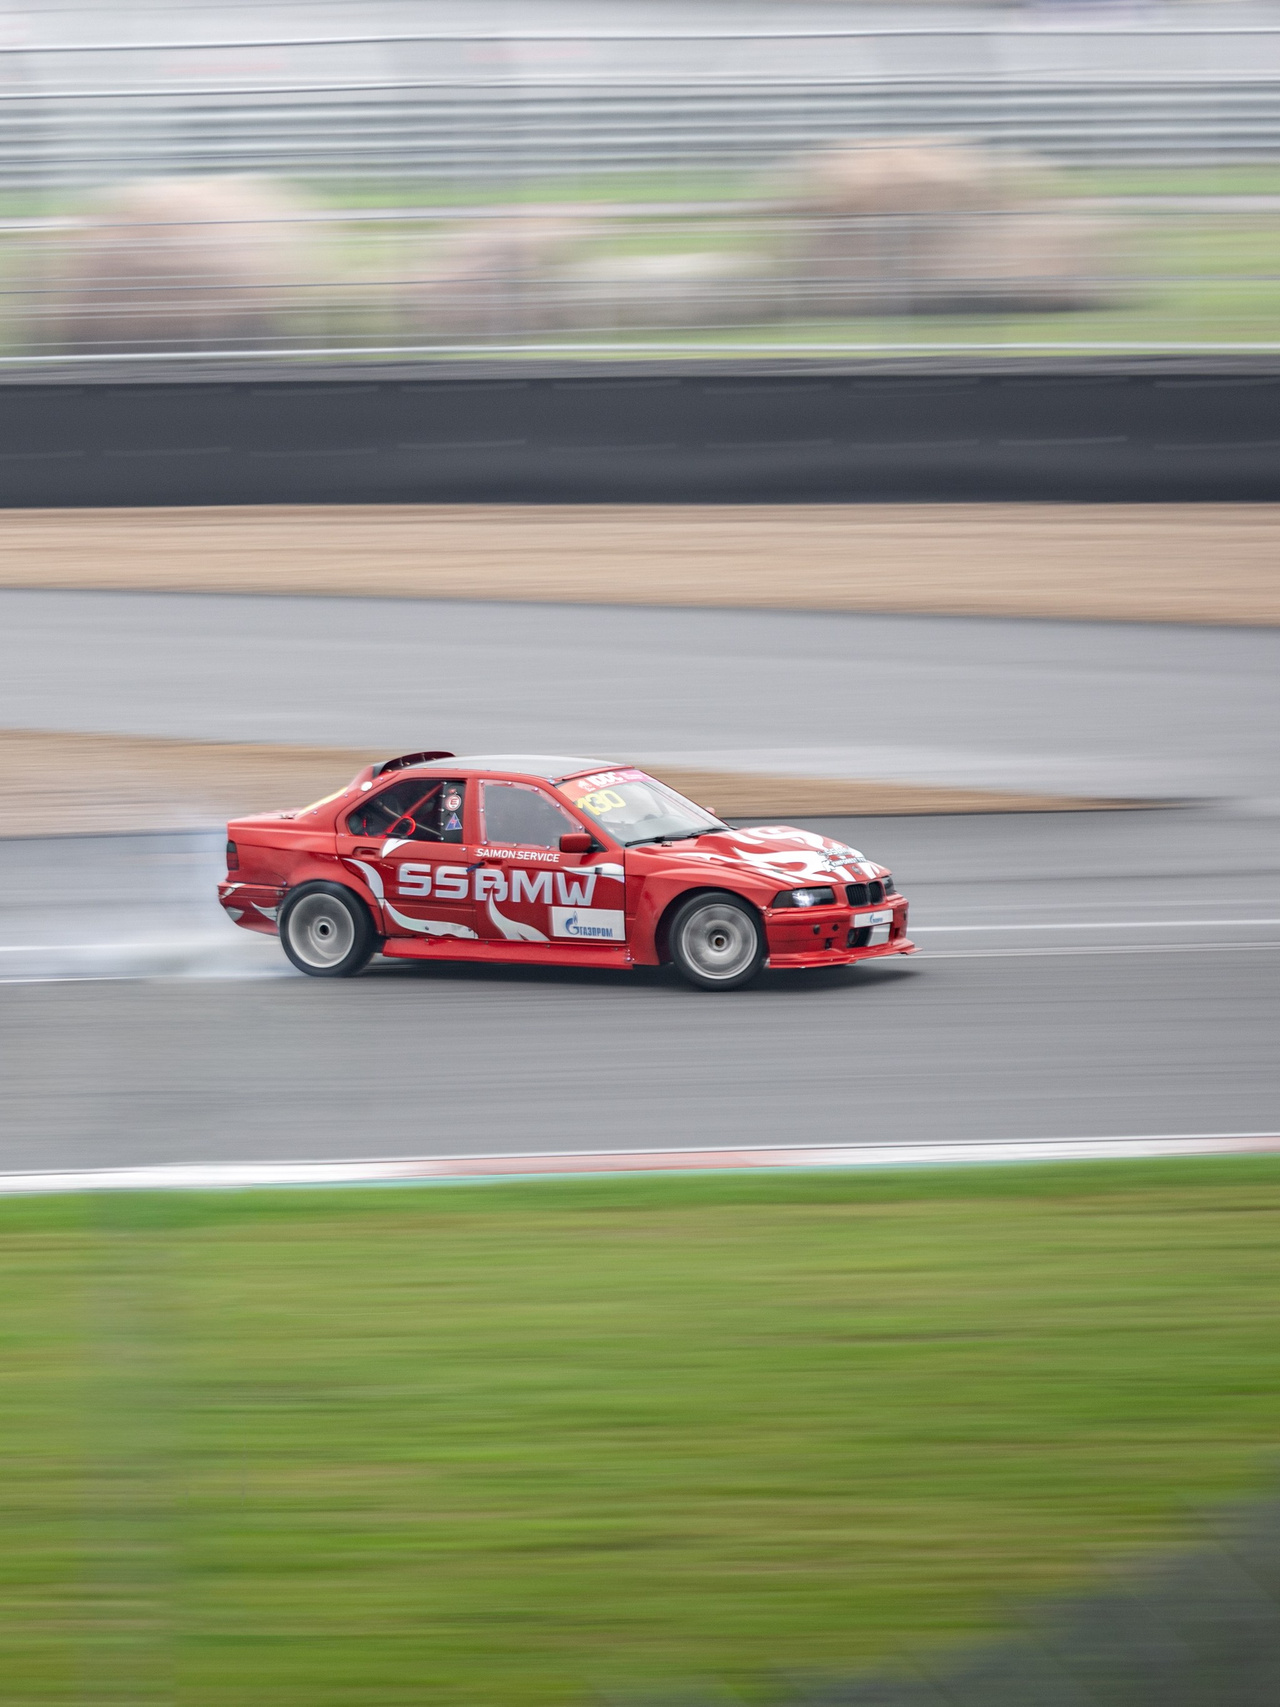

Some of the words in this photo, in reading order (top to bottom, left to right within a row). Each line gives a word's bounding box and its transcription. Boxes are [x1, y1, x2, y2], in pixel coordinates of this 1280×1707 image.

[577, 789, 626, 815] 130
[475, 848, 517, 859] SAIMON
[516, 851, 560, 862] SERVICE
[397, 862, 597, 907] SSBMW
[579, 926, 614, 937] ГАЗПРОМ
